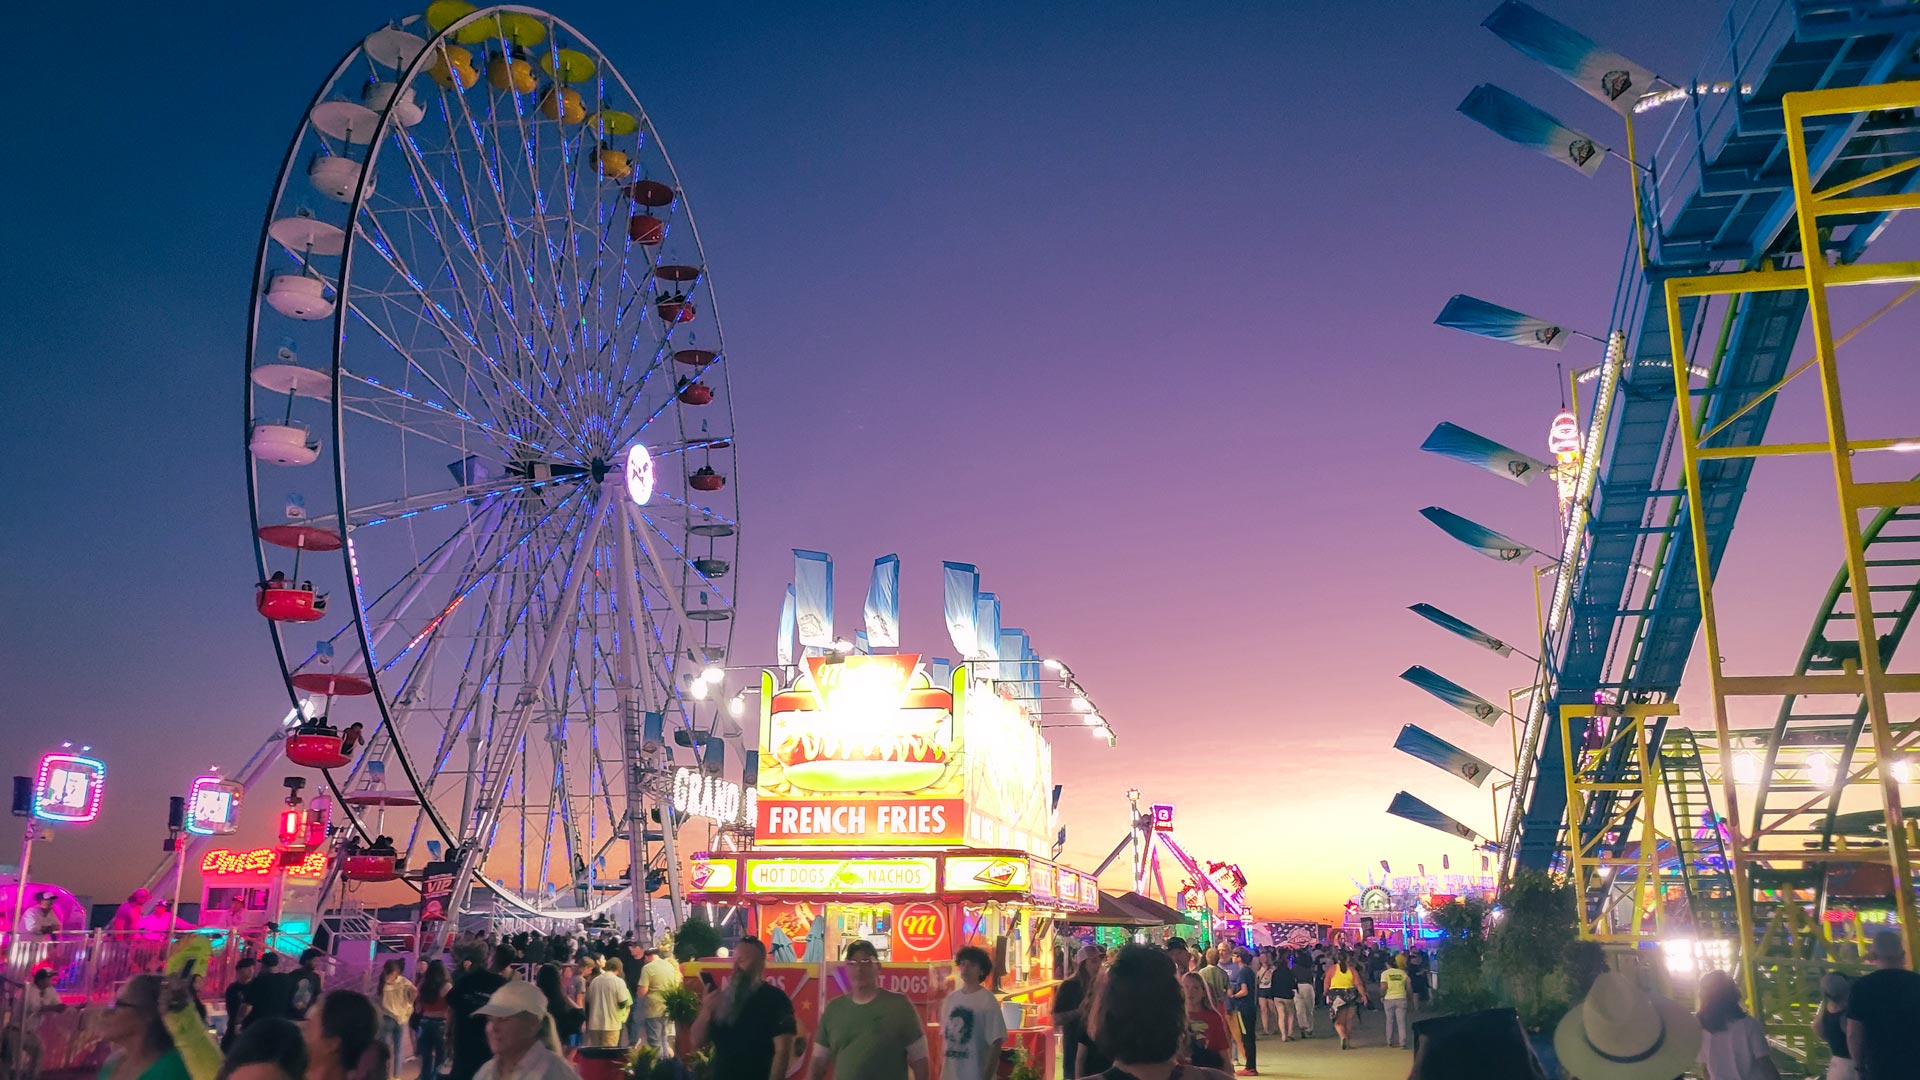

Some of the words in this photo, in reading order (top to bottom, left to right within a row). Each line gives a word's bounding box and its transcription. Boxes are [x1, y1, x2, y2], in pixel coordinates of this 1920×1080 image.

[673, 767, 739, 824] GRAND
[769, 806, 866, 834] FRENCH
[877, 805, 946, 834] FRIES
[760, 868, 785, 883] HOT
[789, 868, 825, 884] DOGS
[868, 869, 922, 884] NACHOS
[427, 880, 452, 893] VIP
[891, 975, 928, 994] DOGS
